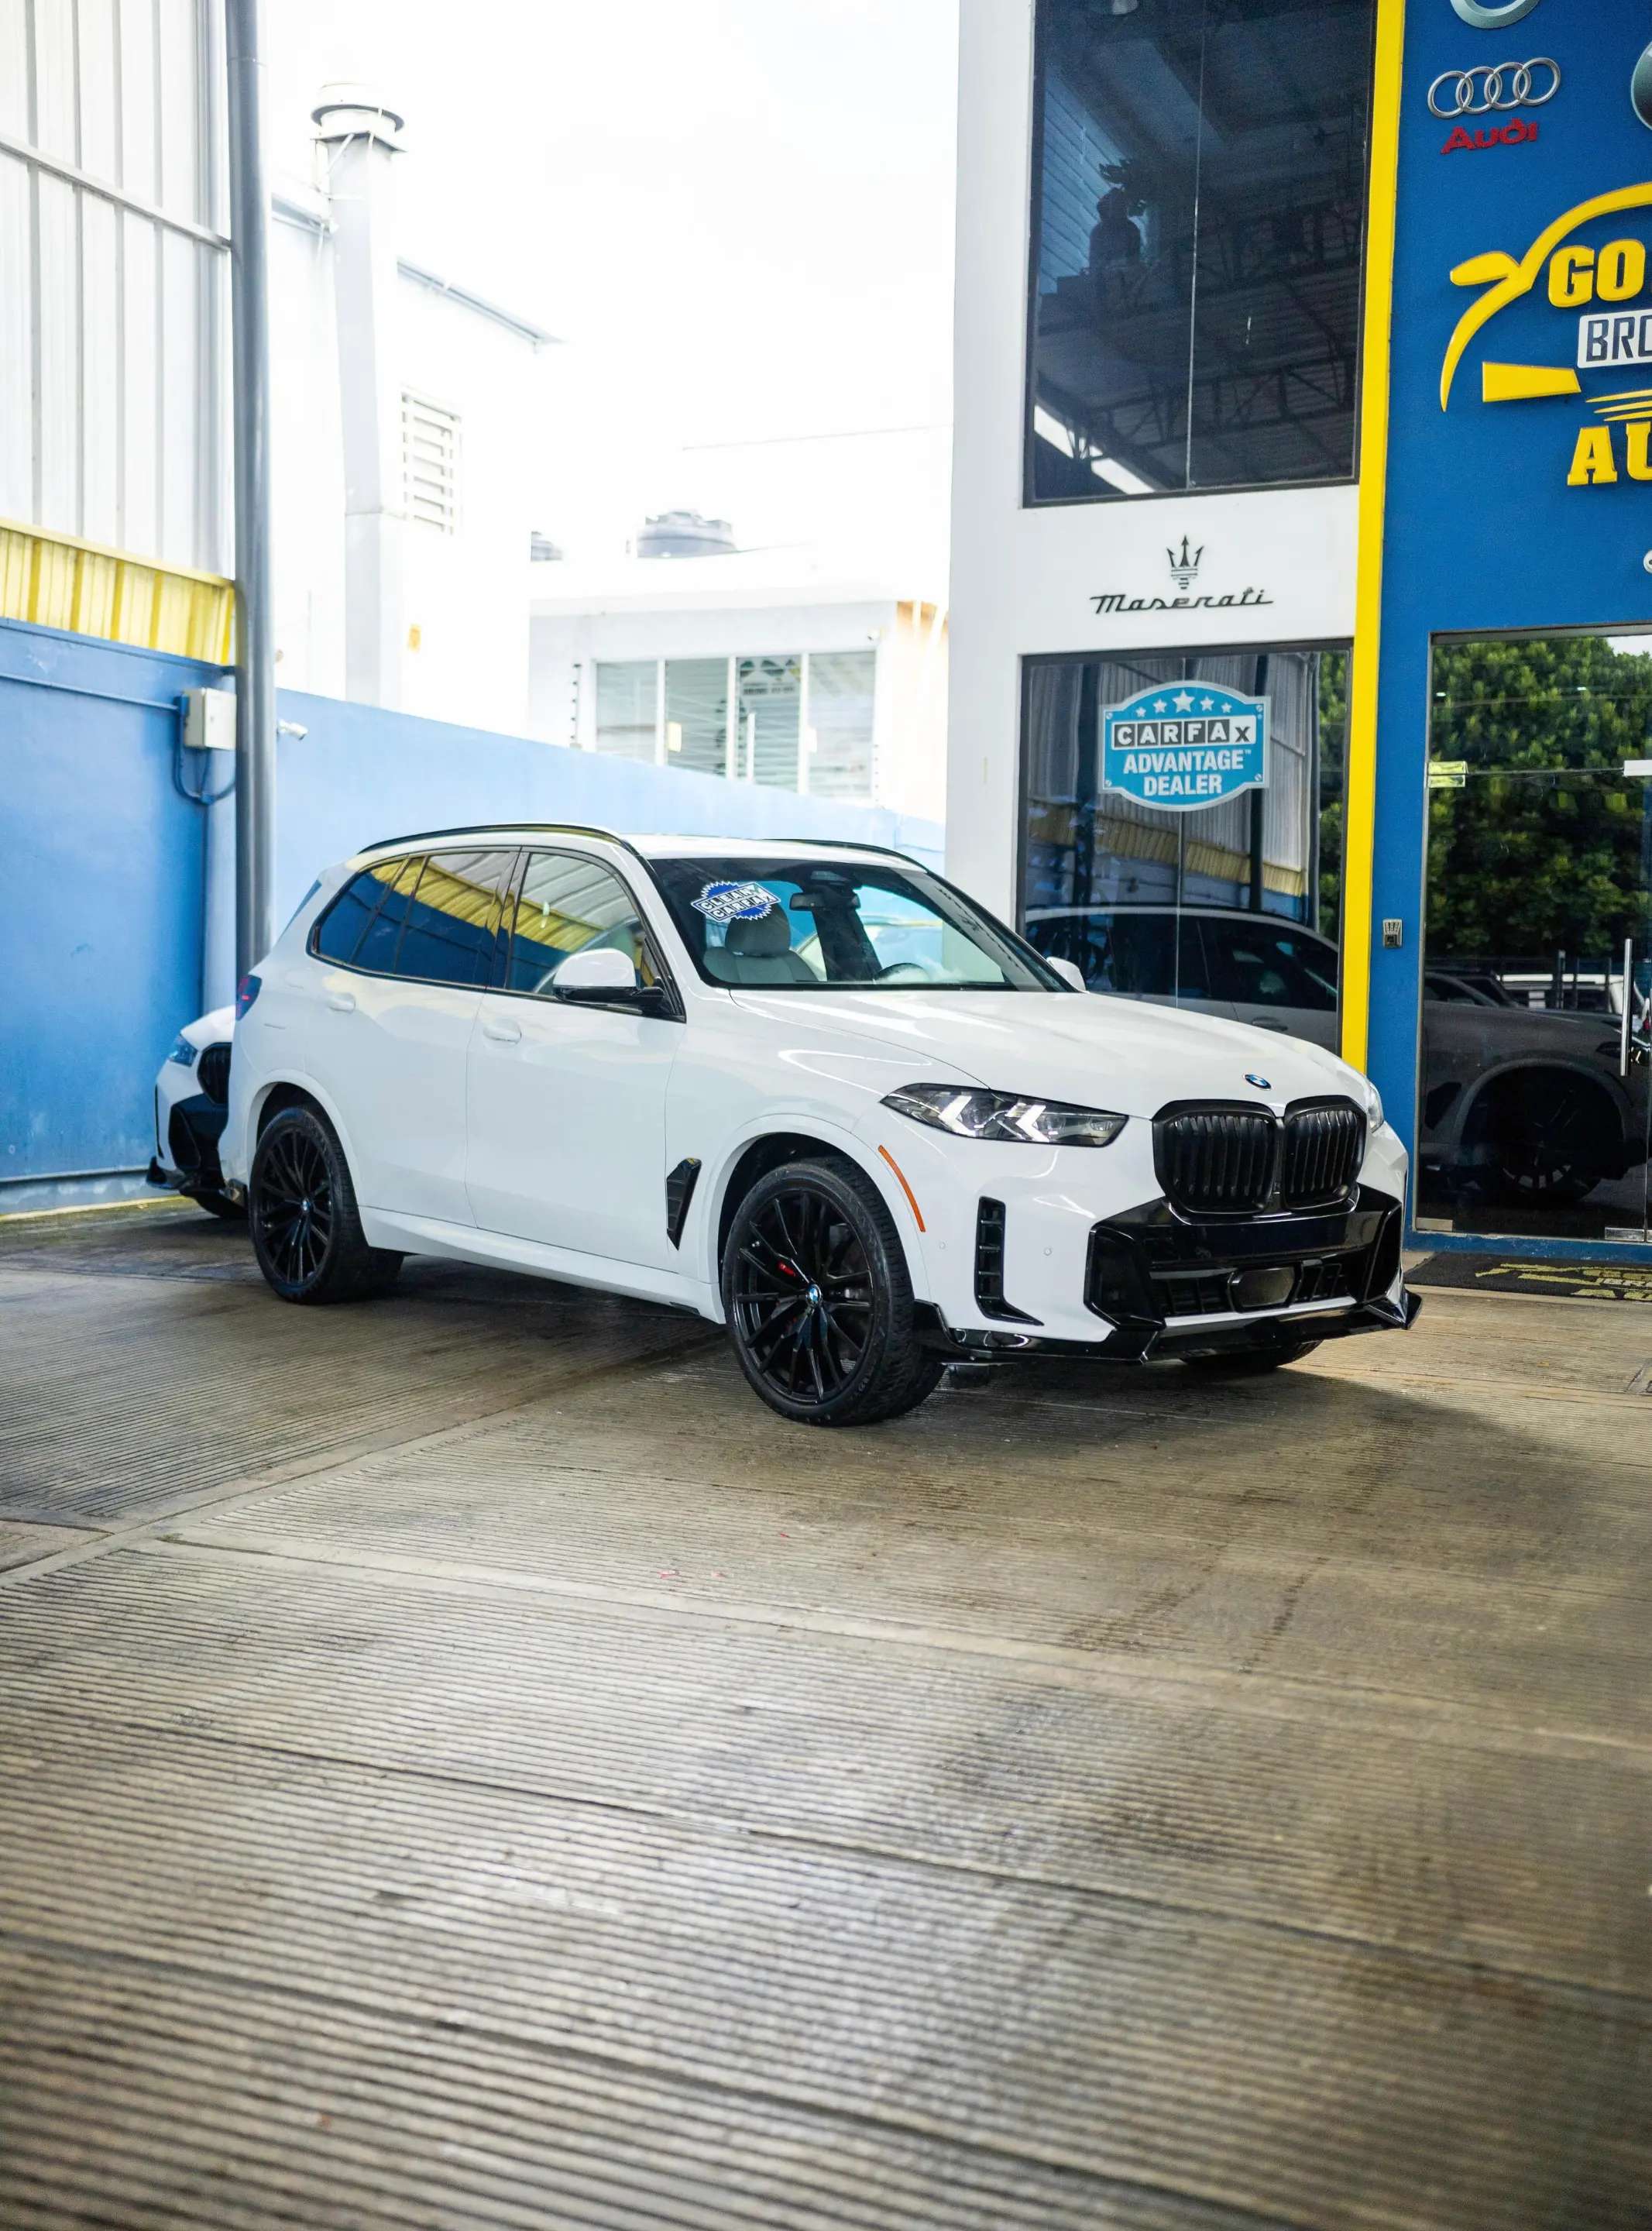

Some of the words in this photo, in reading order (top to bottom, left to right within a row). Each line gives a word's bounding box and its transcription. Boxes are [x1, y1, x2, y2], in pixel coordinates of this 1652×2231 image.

[1441, 118, 1538, 154] Audi
[1089, 586, 1274, 614] Maserati
[1115, 720, 1252, 746] CARFAX
[1143, 775, 1222, 796] DEALER
[700, 887, 754, 910] CLEAN
[712, 895, 773, 918] CARFAX
